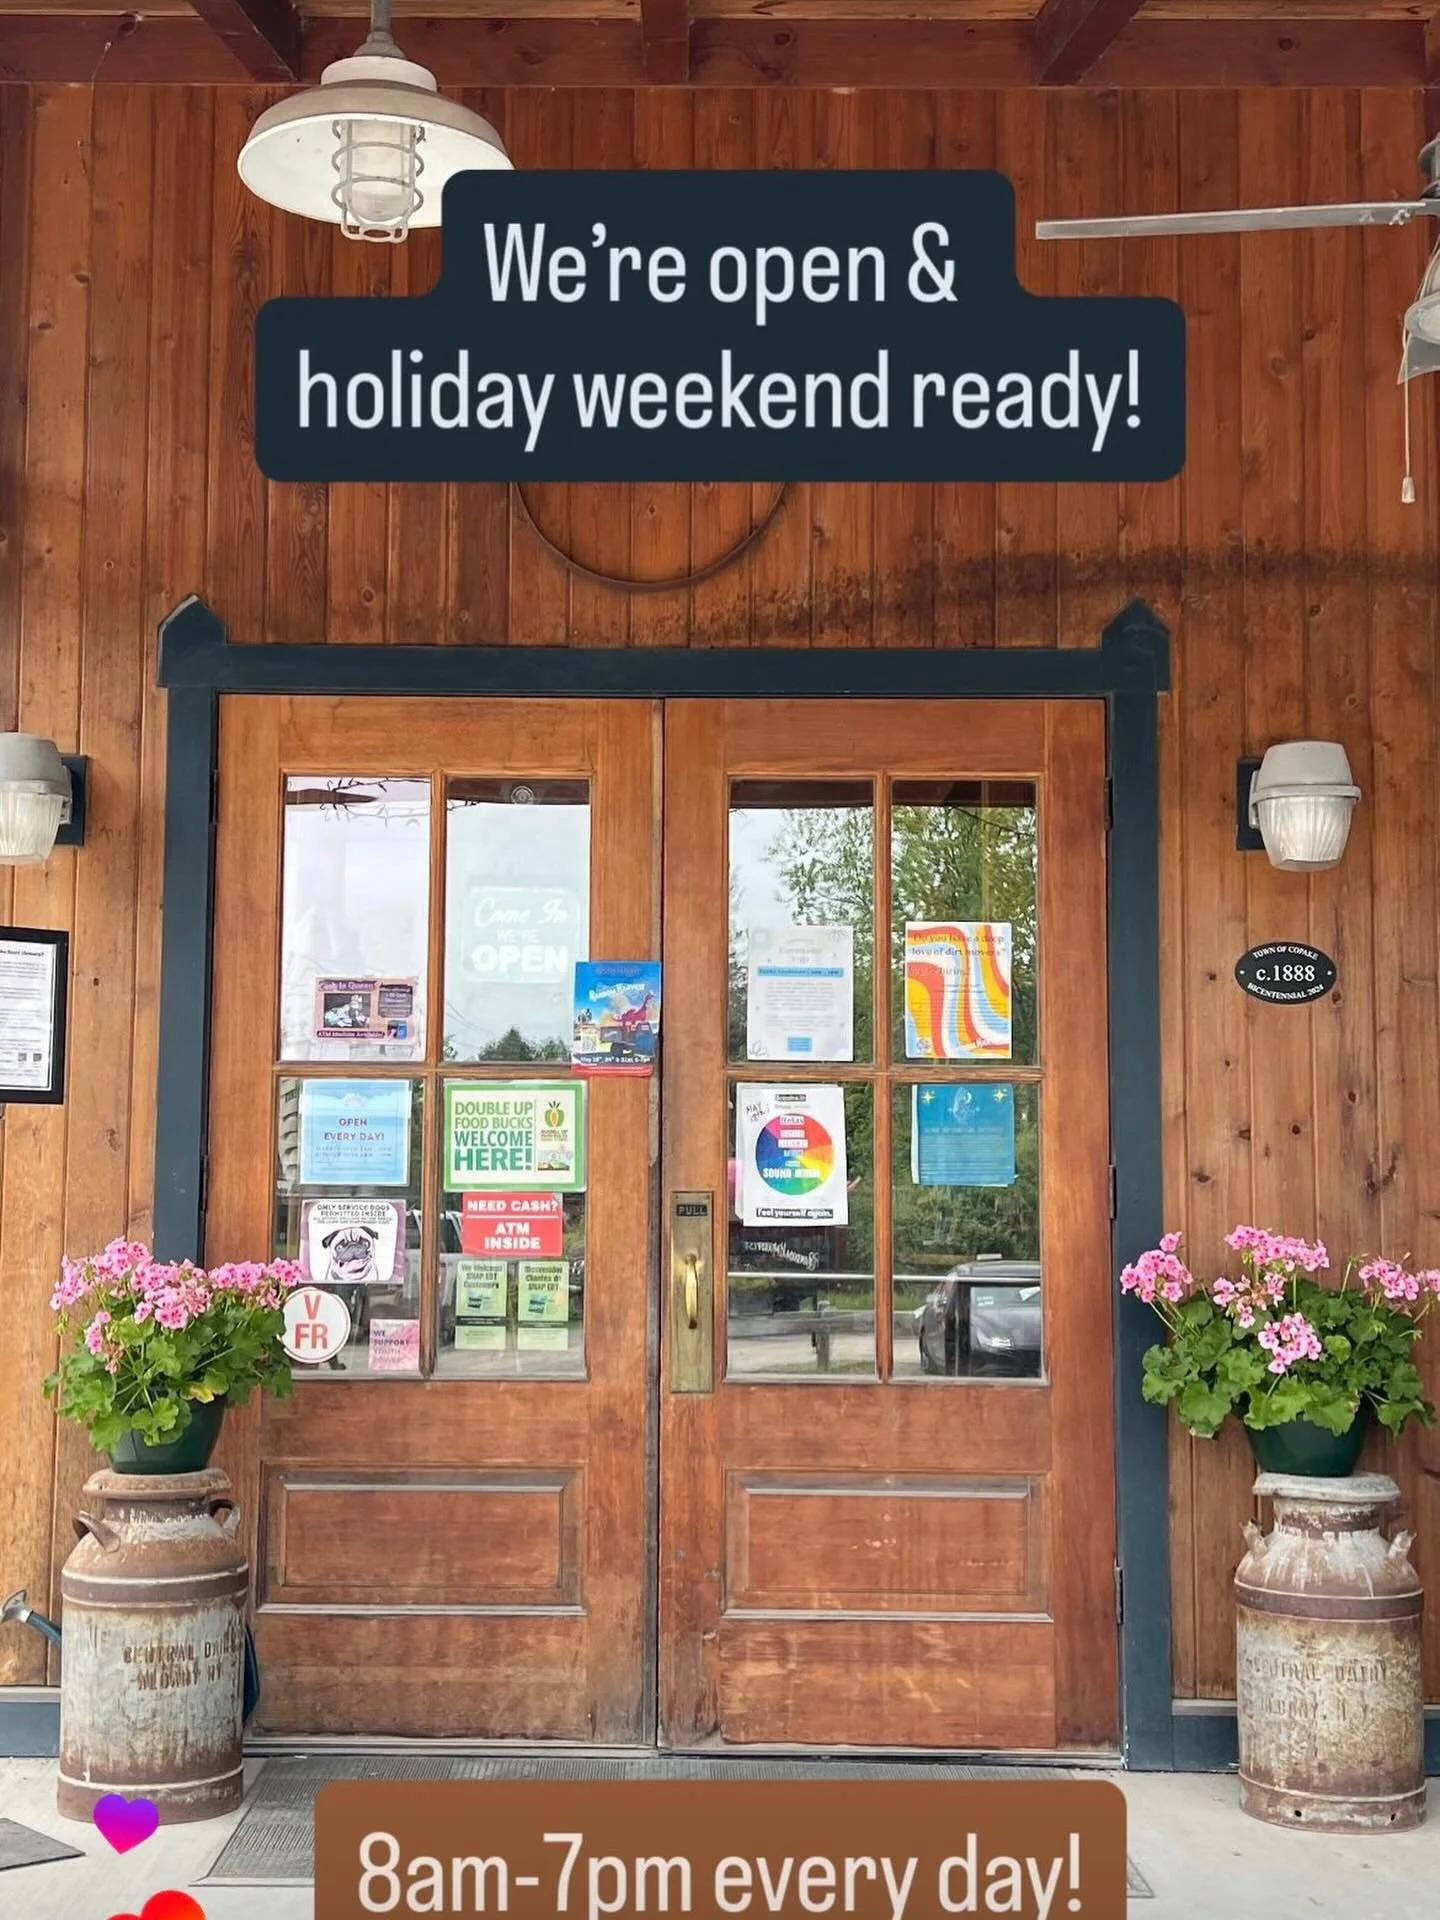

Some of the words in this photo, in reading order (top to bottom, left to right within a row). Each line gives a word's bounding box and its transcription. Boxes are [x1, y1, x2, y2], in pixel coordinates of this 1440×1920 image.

[474, 896, 531, 927] Come
[537, 897, 568, 924] In
[471, 944, 569, 974] OPEN
[1252, 947, 1276, 959] TOWN
[1276, 945, 1287, 953] OF
[1287, 945, 1319, 960] COPAKE
[1247, 982, 1307, 1000] BICENTENNIAL
[455, 1101, 510, 1115] DOUBLE
[513, 1101, 533, 1115] UP
[746, 1102, 762, 1115] MAY
[338, 1117, 368, 1127] OPEN
[455, 1116, 489, 1129] FOOD
[492, 1116, 533, 1129] BUCKS
[324, 1131, 356, 1141] EVERY
[359, 1131, 385, 1141] DAY!
[454, 1130, 533, 1147] WELCOME
[454, 1148, 533, 1171] HERE!
[762, 1168, 792, 1179] SOUND
[317, 1203, 337, 1211] ONLY
[338, 1203, 368, 1211] SERVICE
[369, 1203, 391, 1211] DOGS
[467, 1199, 506, 1212] NEED
[511, 1199, 559, 1212] CASH?
[679, 1205, 707, 1216] PULL
[757, 1207, 774, 1218] Feel
[774, 1207, 808, 1219] yourself
[495, 1222, 530, 1236] ATM
[484, 1236, 541, 1249] INSIDE
[303, 1294, 322, 1320] V
[294, 1322, 329, 1350] FR
[373, 1339, 410, 1347] SUPPORT
